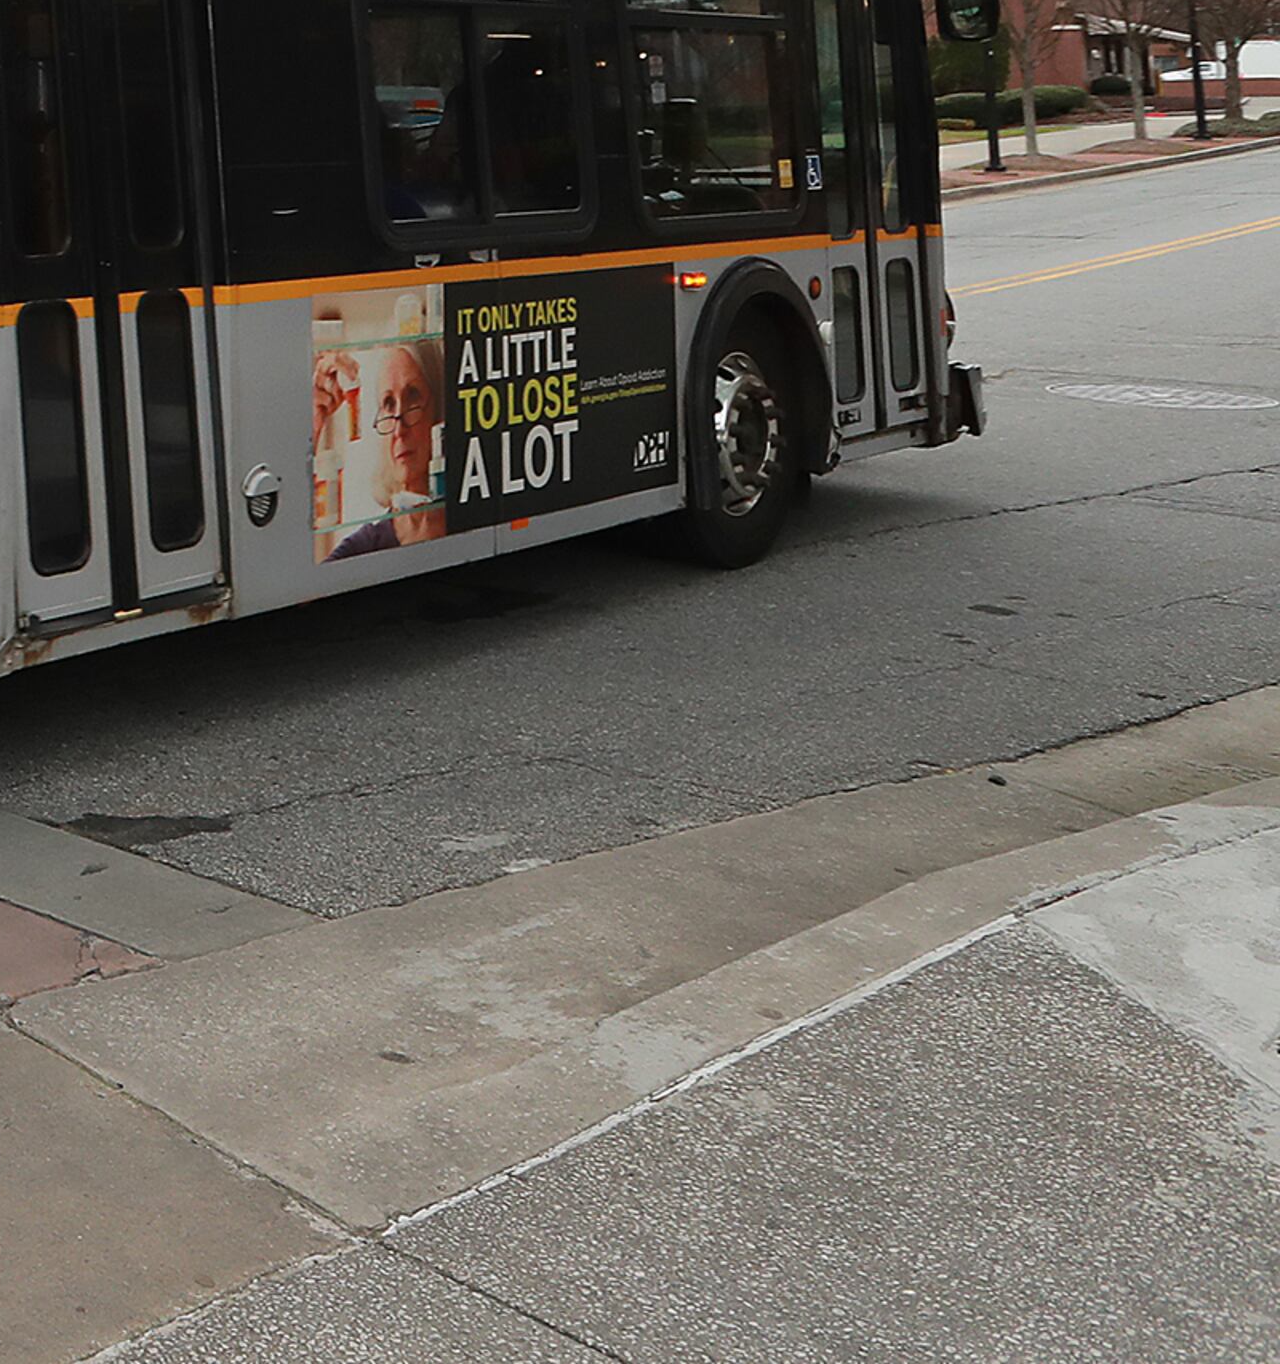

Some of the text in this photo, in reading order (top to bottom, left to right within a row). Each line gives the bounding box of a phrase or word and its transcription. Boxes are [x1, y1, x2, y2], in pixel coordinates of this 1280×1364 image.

[457, 297, 577, 335] IT ONLY TAKES
[458, 327, 577, 384] A LITTLE
[458, 385, 500, 432] TO
[508, 373, 579, 425] LOSE
[459, 419, 579, 503] A LOT
[633, 431, 669, 467] DPH
